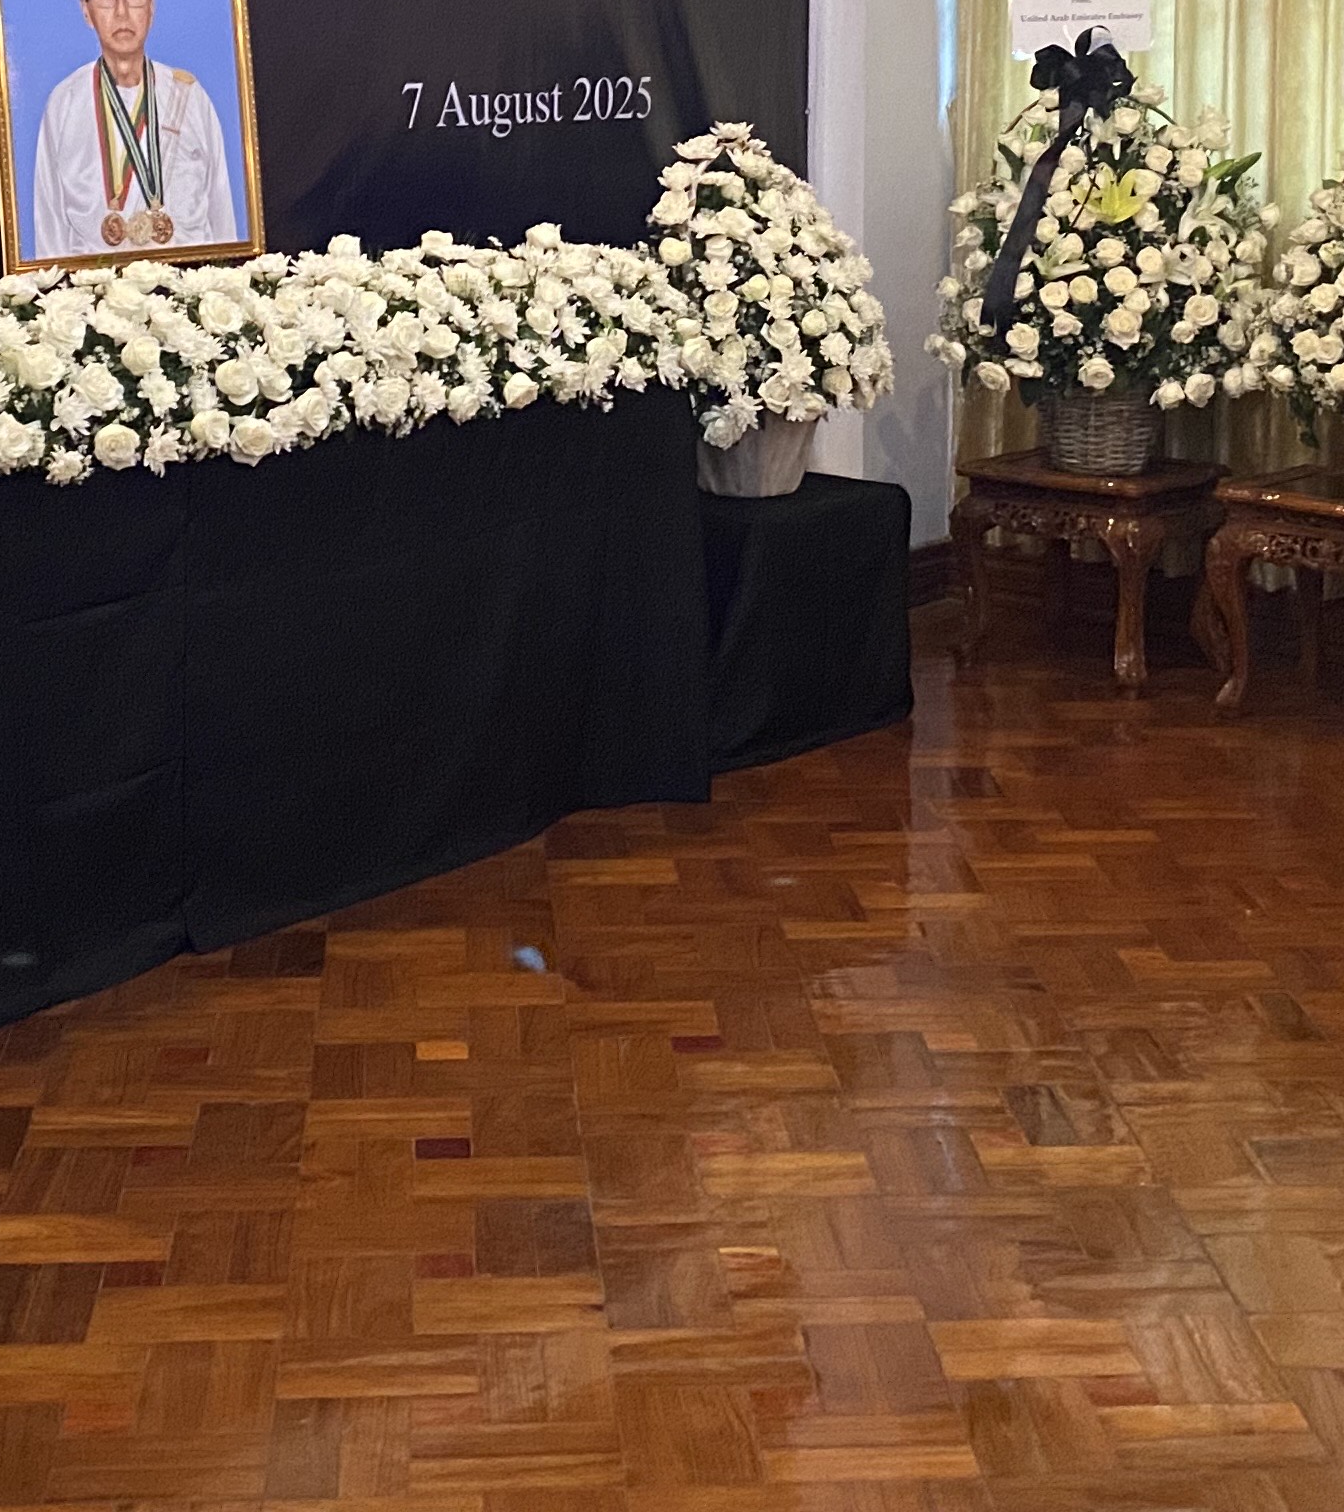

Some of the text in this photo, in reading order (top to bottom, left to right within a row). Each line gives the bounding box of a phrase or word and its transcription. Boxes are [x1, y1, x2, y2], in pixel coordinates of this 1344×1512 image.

[1020, 14, 1048, 23] United
[1049, 14, 1070, 22] Arab
[401, 76, 652, 138] 7 August 2025
